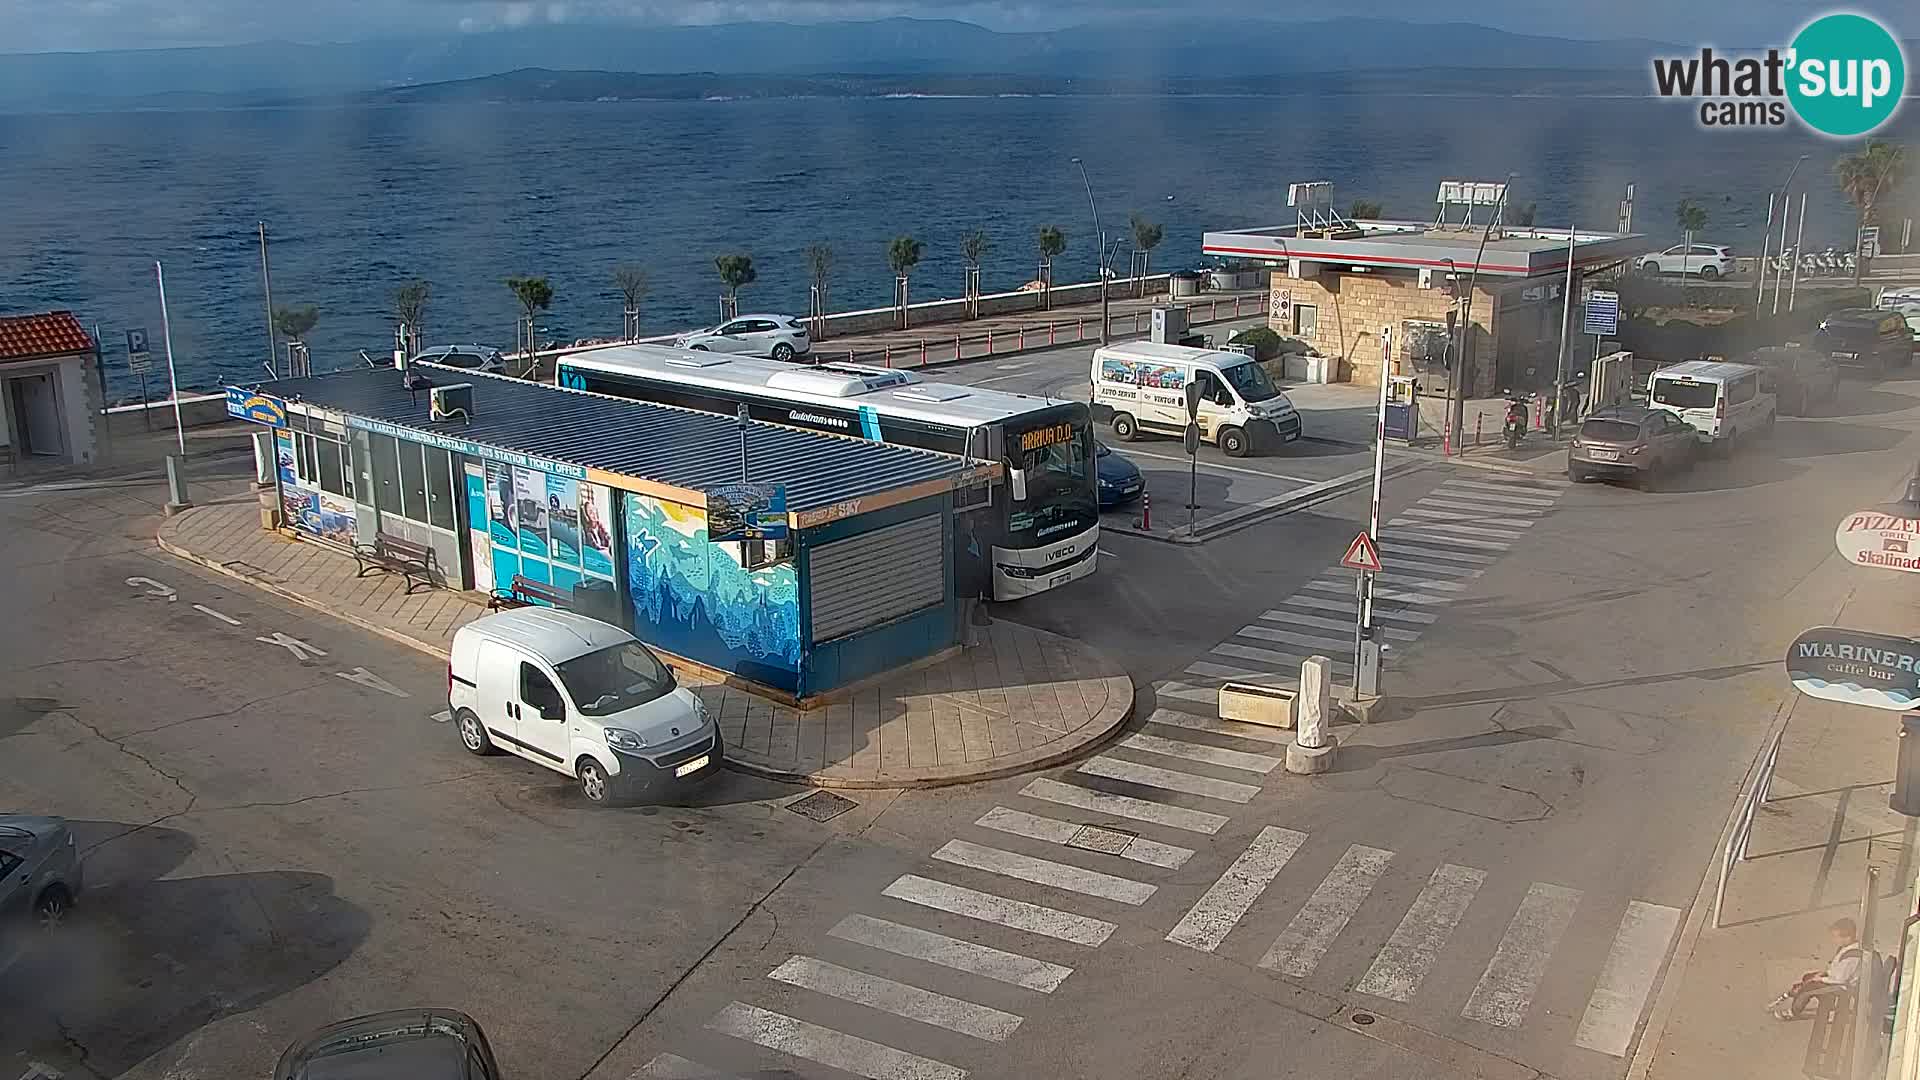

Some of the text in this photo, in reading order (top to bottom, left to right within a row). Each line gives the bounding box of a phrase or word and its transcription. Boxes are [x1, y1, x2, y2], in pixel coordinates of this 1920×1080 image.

[1101, 387, 1117, 397] AUTO
[1118, 390, 1136, 399] SERVIS
[1154, 395, 1176, 405] VIKTOR
[789, 409, 828, 425] Autotrans
[1021, 428, 1055, 451] ARRIVA
[397, 427, 437, 446] AUTOBUSNA
[437, 436, 468, 452] POSTAJA
[478, 446, 494, 458] BUS
[494, 450, 526, 465] STATION
[528, 457, 555, 473] TICKET
[556, 463, 583, 477] OFFICE
[1880, 531, 1916, 541] GRILL
[1045, 545, 1076, 562] IVECO
[1827, 663, 1895, 681] caffe bar
